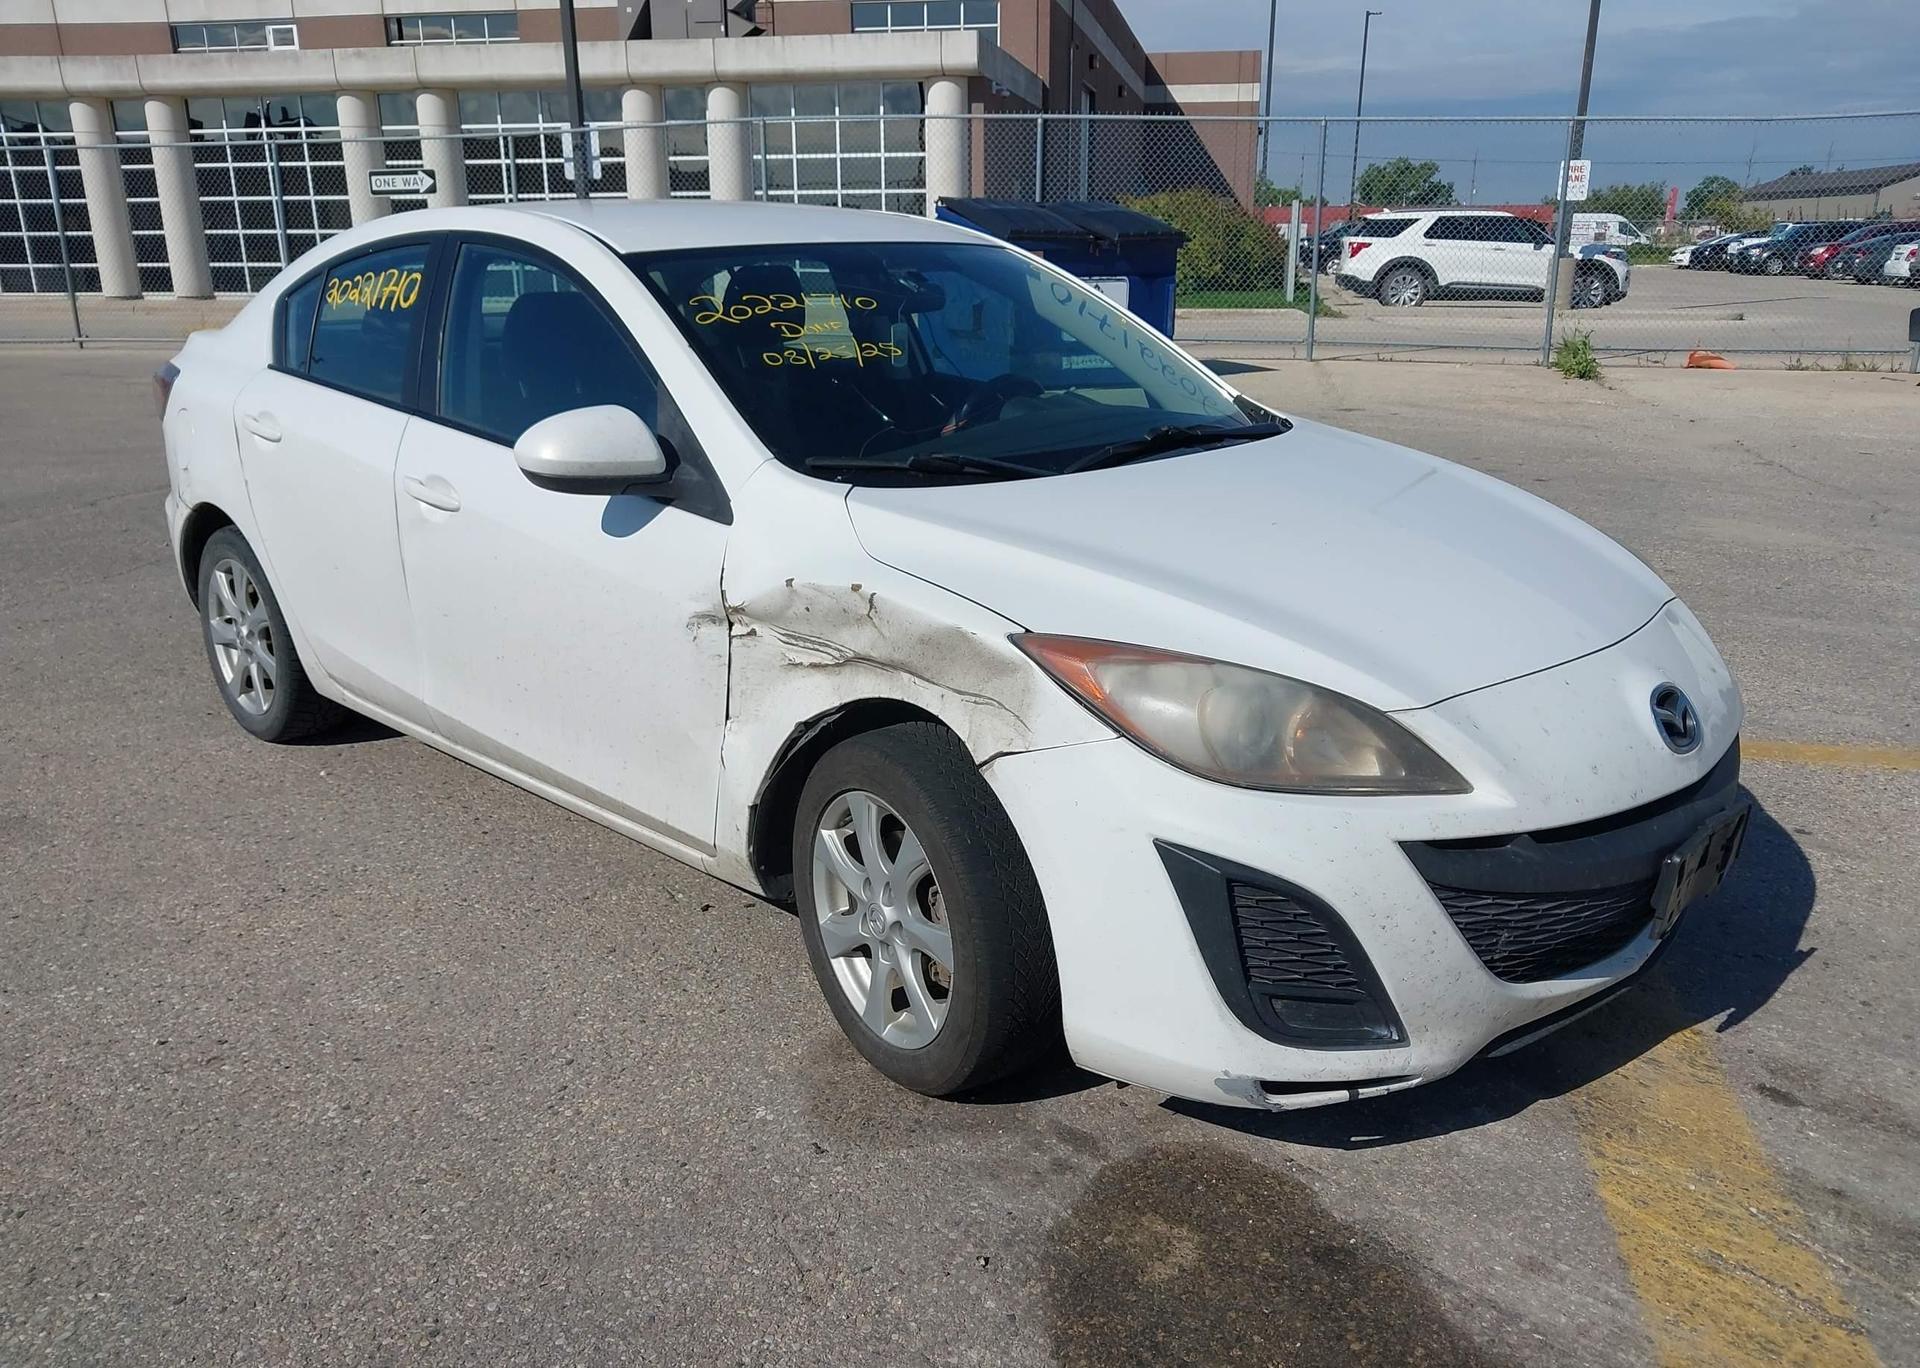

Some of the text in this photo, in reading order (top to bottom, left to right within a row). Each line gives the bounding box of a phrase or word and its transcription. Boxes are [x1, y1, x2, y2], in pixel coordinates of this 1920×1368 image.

[1569, 165, 1585, 173] IRE
[374, 176, 425, 188] ONE WAY
[1568, 174, 1586, 183] ANE
[689, 292, 877, 324] 20221710
